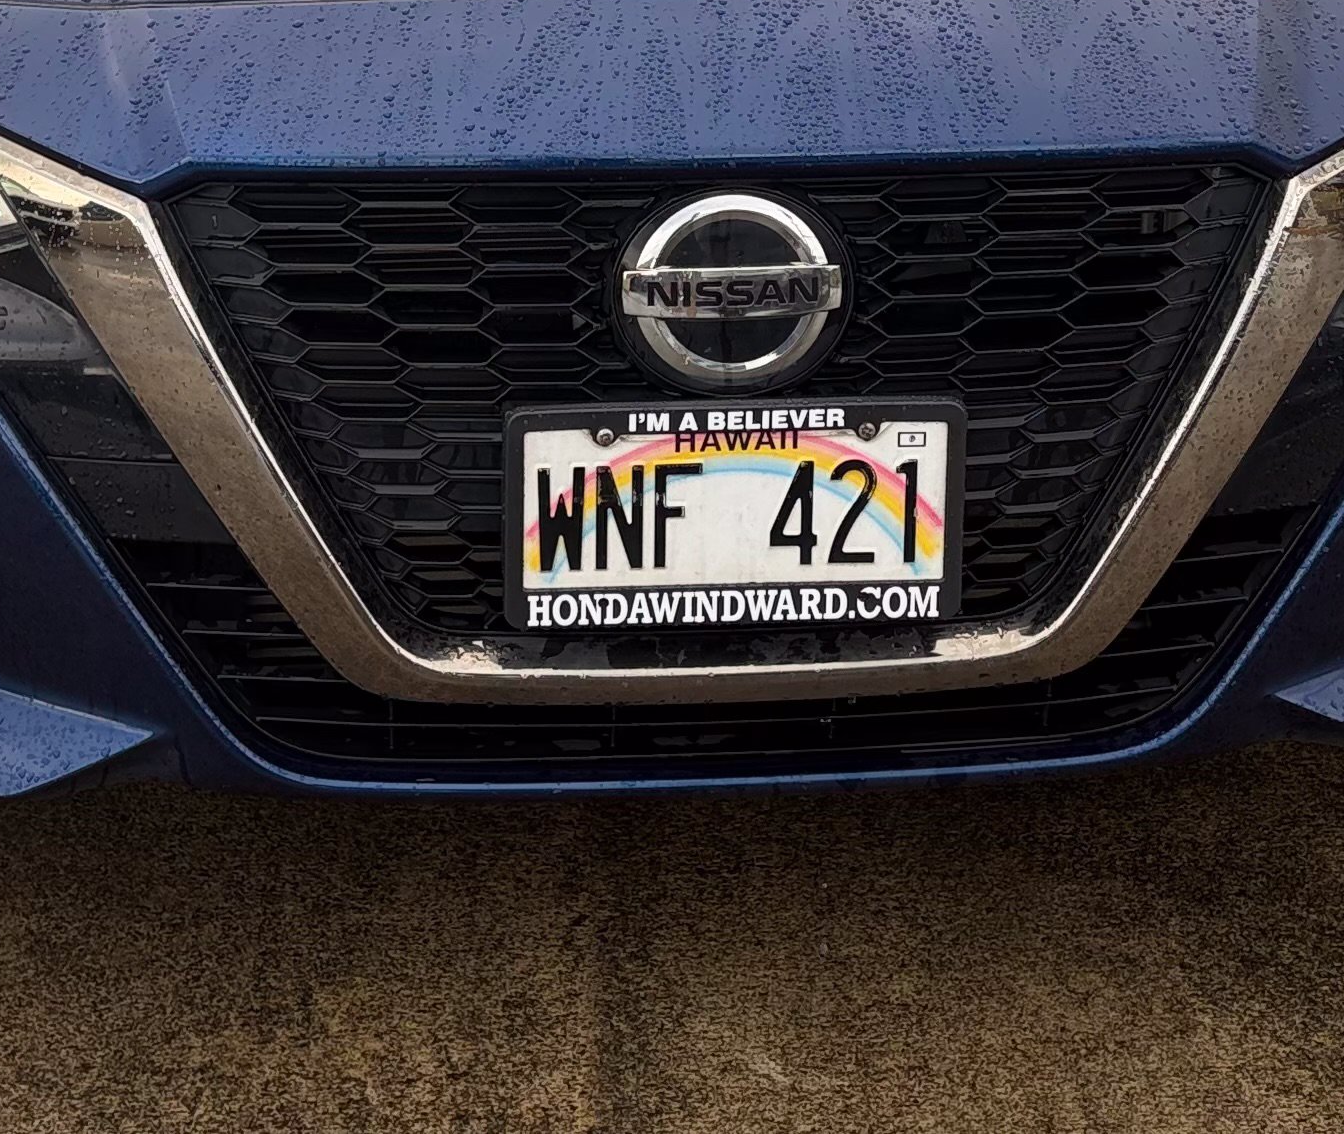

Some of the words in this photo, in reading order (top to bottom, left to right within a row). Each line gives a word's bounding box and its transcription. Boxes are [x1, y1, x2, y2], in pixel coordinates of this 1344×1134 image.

[646, 276, 819, 308] NISSAN
[628, 412, 670, 432] I'M
[678, 412, 699, 431] A
[707, 408, 845, 431] BELIEVER
[674, 430, 798, 453] HAWAII
[537, 462, 704, 572] WNF
[769, 459, 918, 566] 421
[526, 585, 941, 628] HONDAWINDWARD.COM
